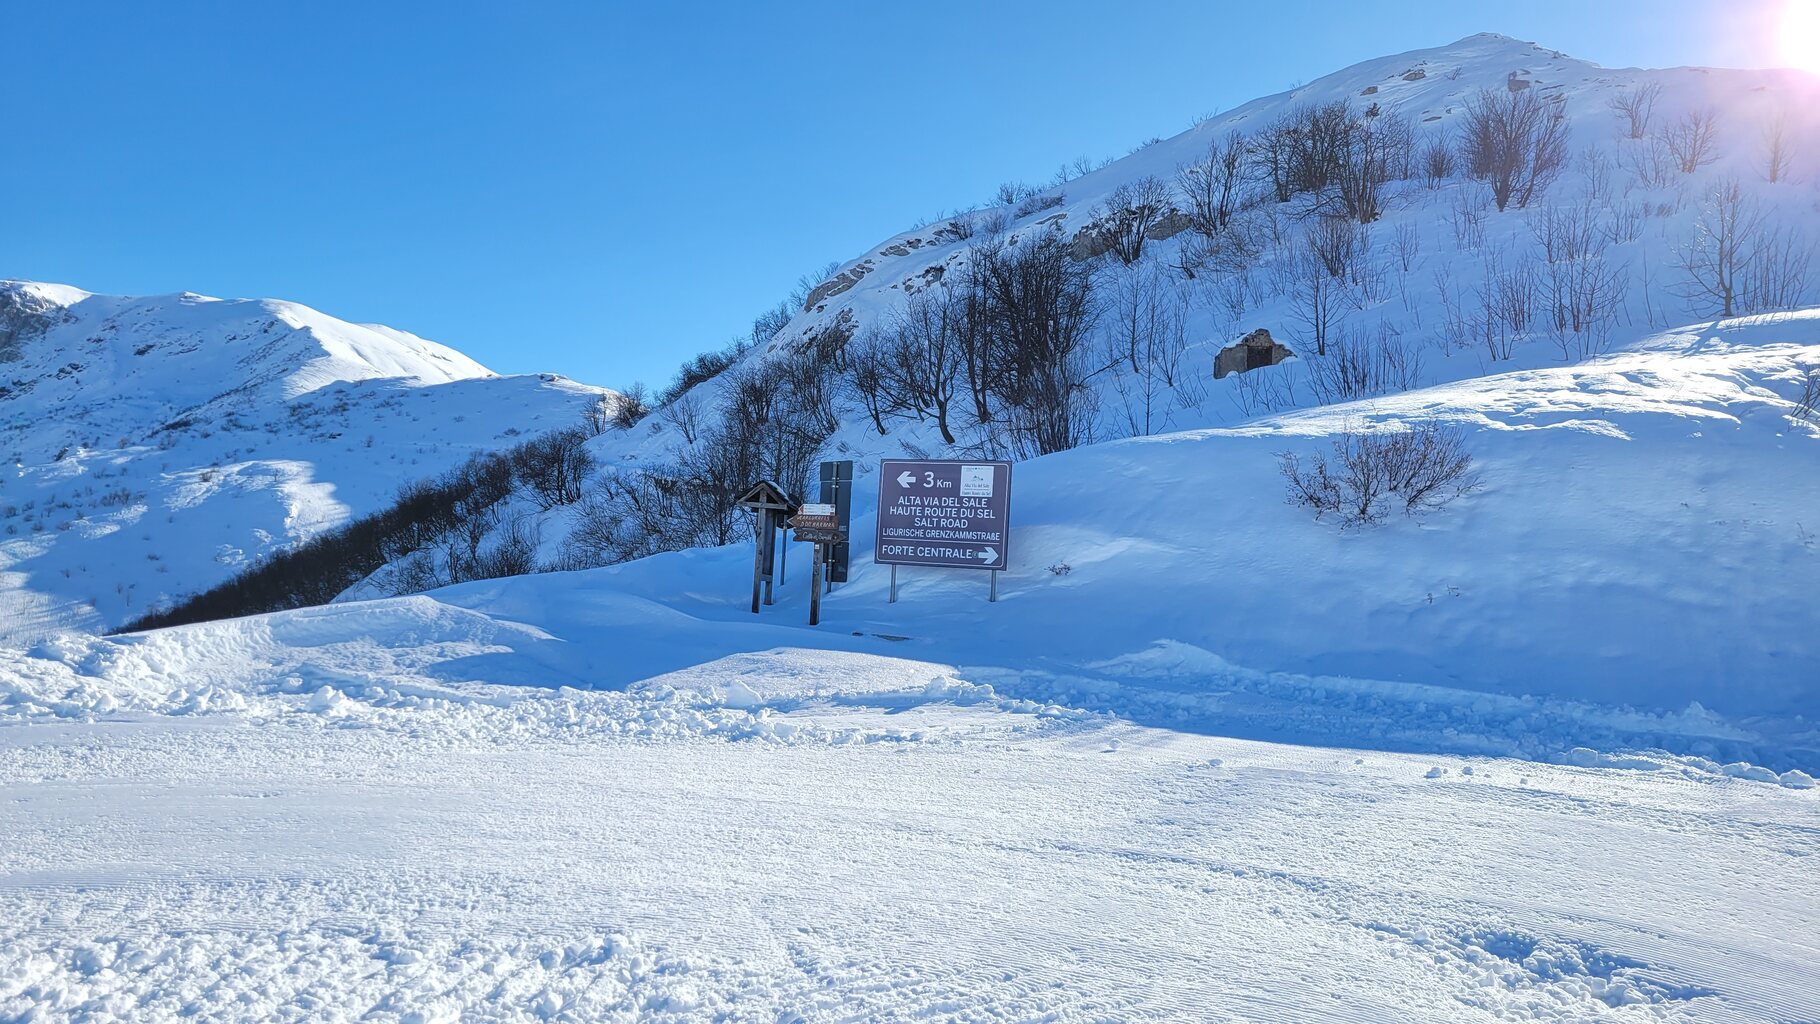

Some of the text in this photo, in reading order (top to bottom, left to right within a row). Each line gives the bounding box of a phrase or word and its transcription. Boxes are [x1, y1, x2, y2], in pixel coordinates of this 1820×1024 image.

[923, 471, 952, 489] 3 Km
[897, 496, 988, 508] ALTA VIA DEL SALE
[889, 506, 996, 519] HAUTE ROUTE DU SEL
[914, 518, 968, 528] SALT ROAD
[882, 528, 924, 538] LIGURISCHE
[882, 545, 973, 559] FORTE CENTRALE
